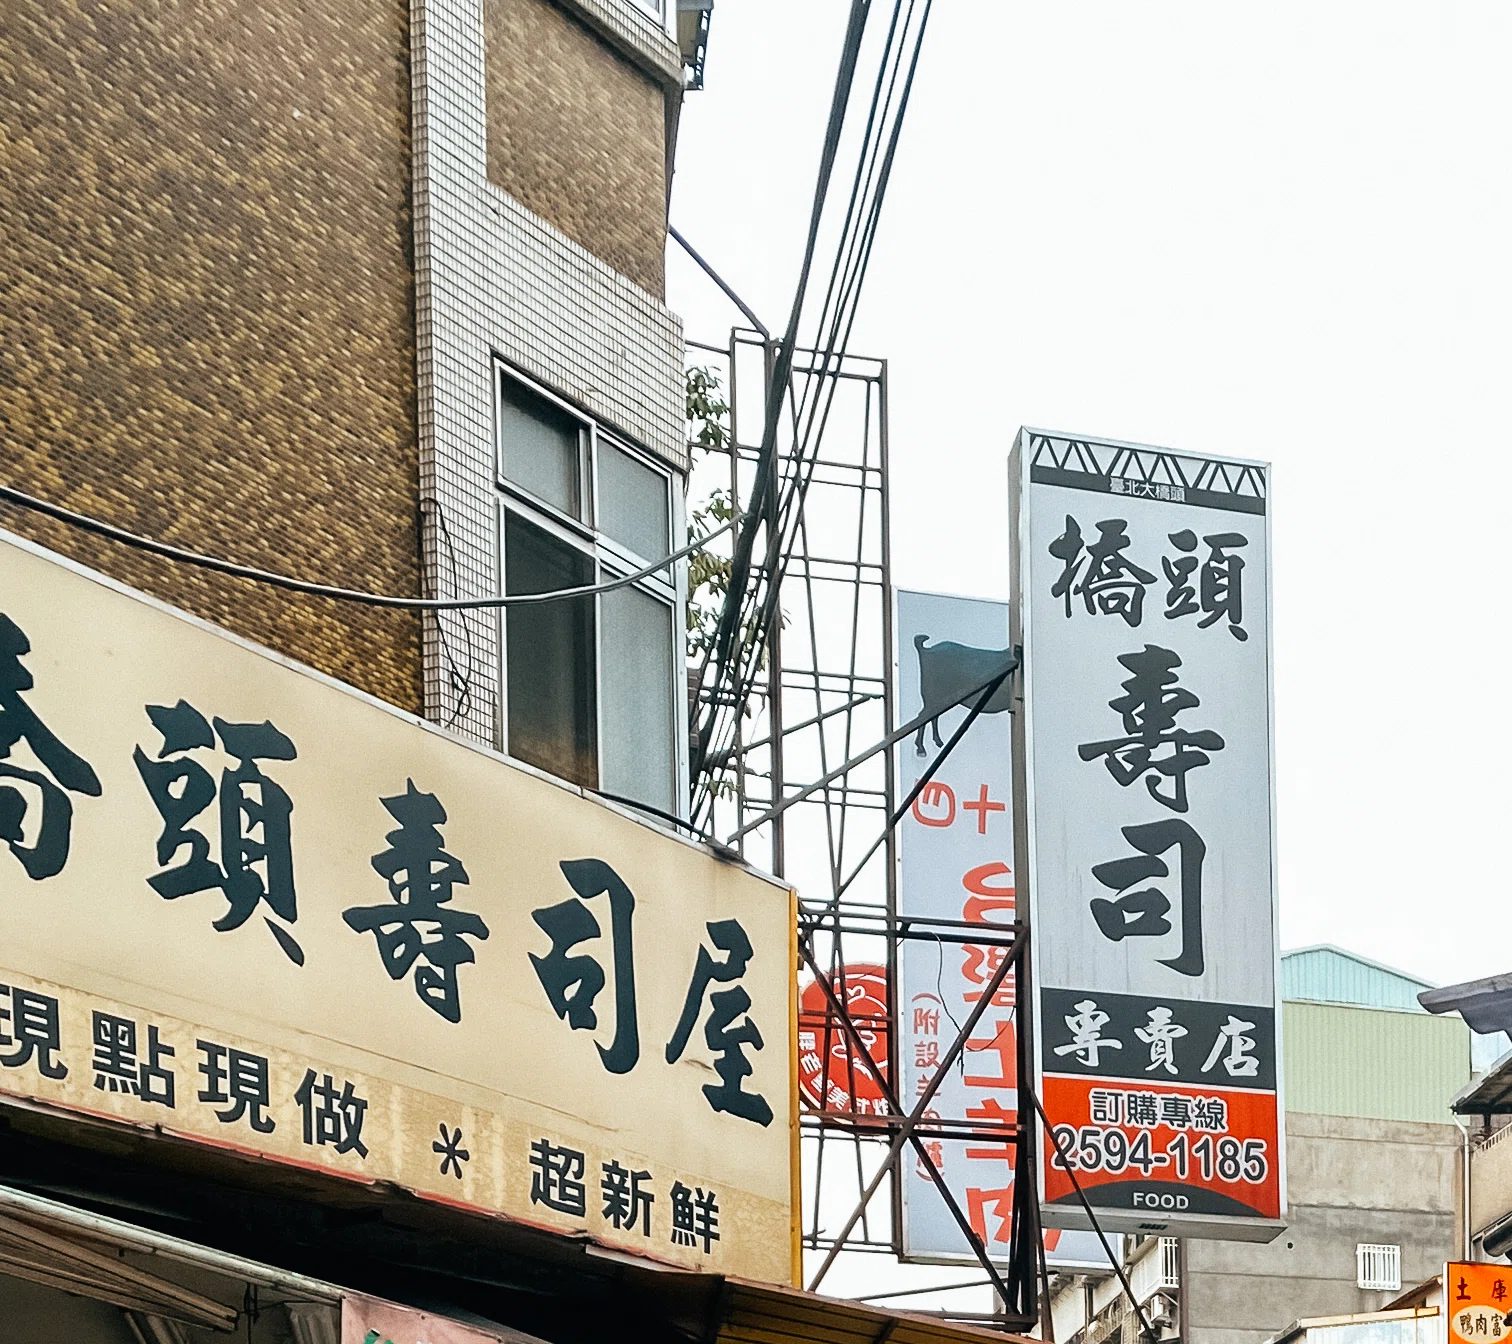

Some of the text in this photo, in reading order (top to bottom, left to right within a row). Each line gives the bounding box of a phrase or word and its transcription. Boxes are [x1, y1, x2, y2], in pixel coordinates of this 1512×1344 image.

[1049, 513, 1249, 642] 橋頭
[1078, 643, 1226, 978] 壽司
[1053, 999, 1261, 1078] 專賣店
[0, 985, 722, 1256] 現點現做 超新鮮
[1088, 1088, 1230, 1133] 訂購專線
[1050, 1124, 1270, 1184] 2594-1185
[1132, 1191, 1190, 1210] FOOD
